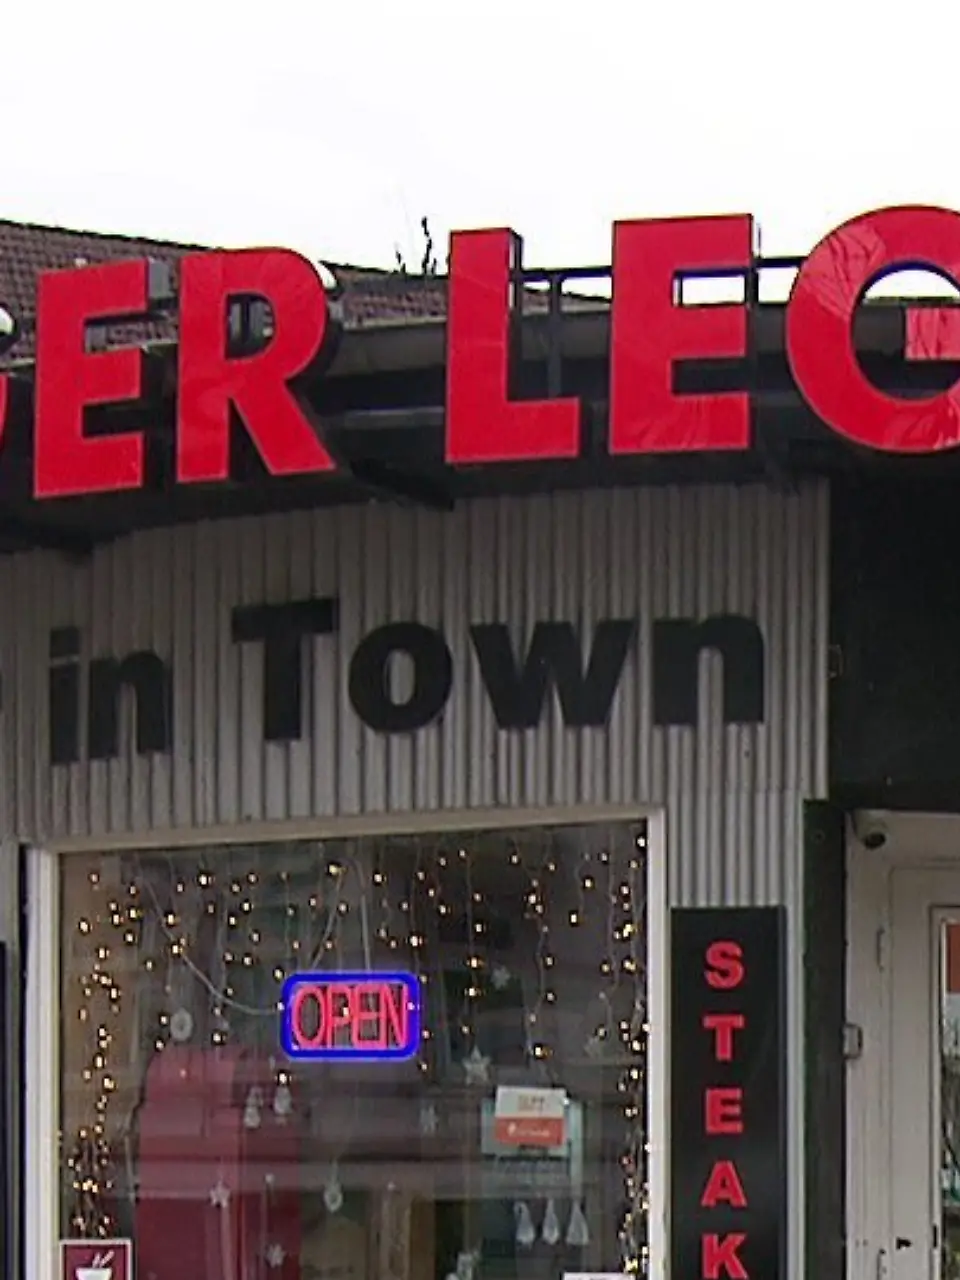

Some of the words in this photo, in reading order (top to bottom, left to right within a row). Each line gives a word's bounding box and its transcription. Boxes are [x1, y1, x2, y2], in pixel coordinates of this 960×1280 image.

[0, 246, 335, 498] ER
[49, 627, 172, 767] in
[232, 597, 764, 742] Town
[290, 982, 410, 1050] OPEN
